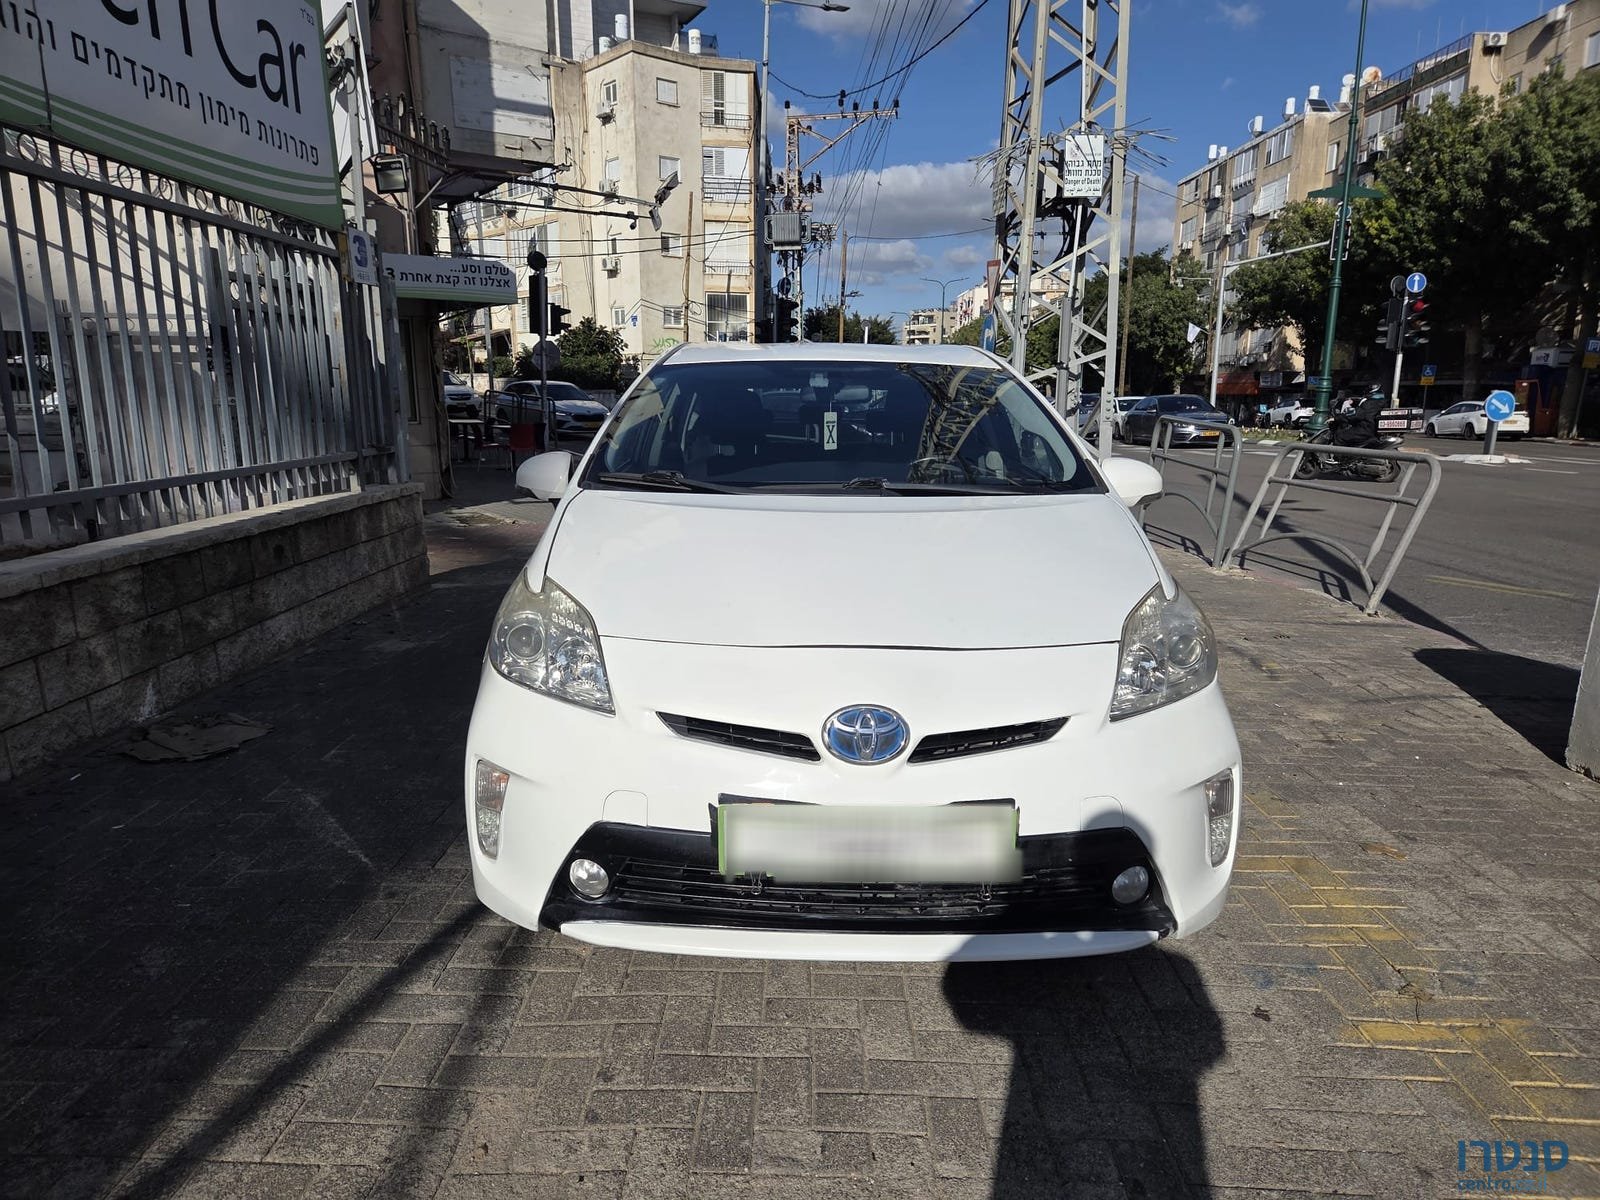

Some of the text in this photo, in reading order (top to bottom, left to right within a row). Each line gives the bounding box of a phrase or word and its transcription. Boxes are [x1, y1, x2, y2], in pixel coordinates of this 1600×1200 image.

[70, 30, 190, 109] מתקדמים
[199, 91, 250, 134] מימון
[257, 119, 319, 166] פתרונות
[1085, 169, 1101, 177] סכנת
[1065, 178, 1080, 186] Danger
[485, 265, 509, 276] שלם
[400, 272, 511, 288] אצלנו זה קצת אחרת
